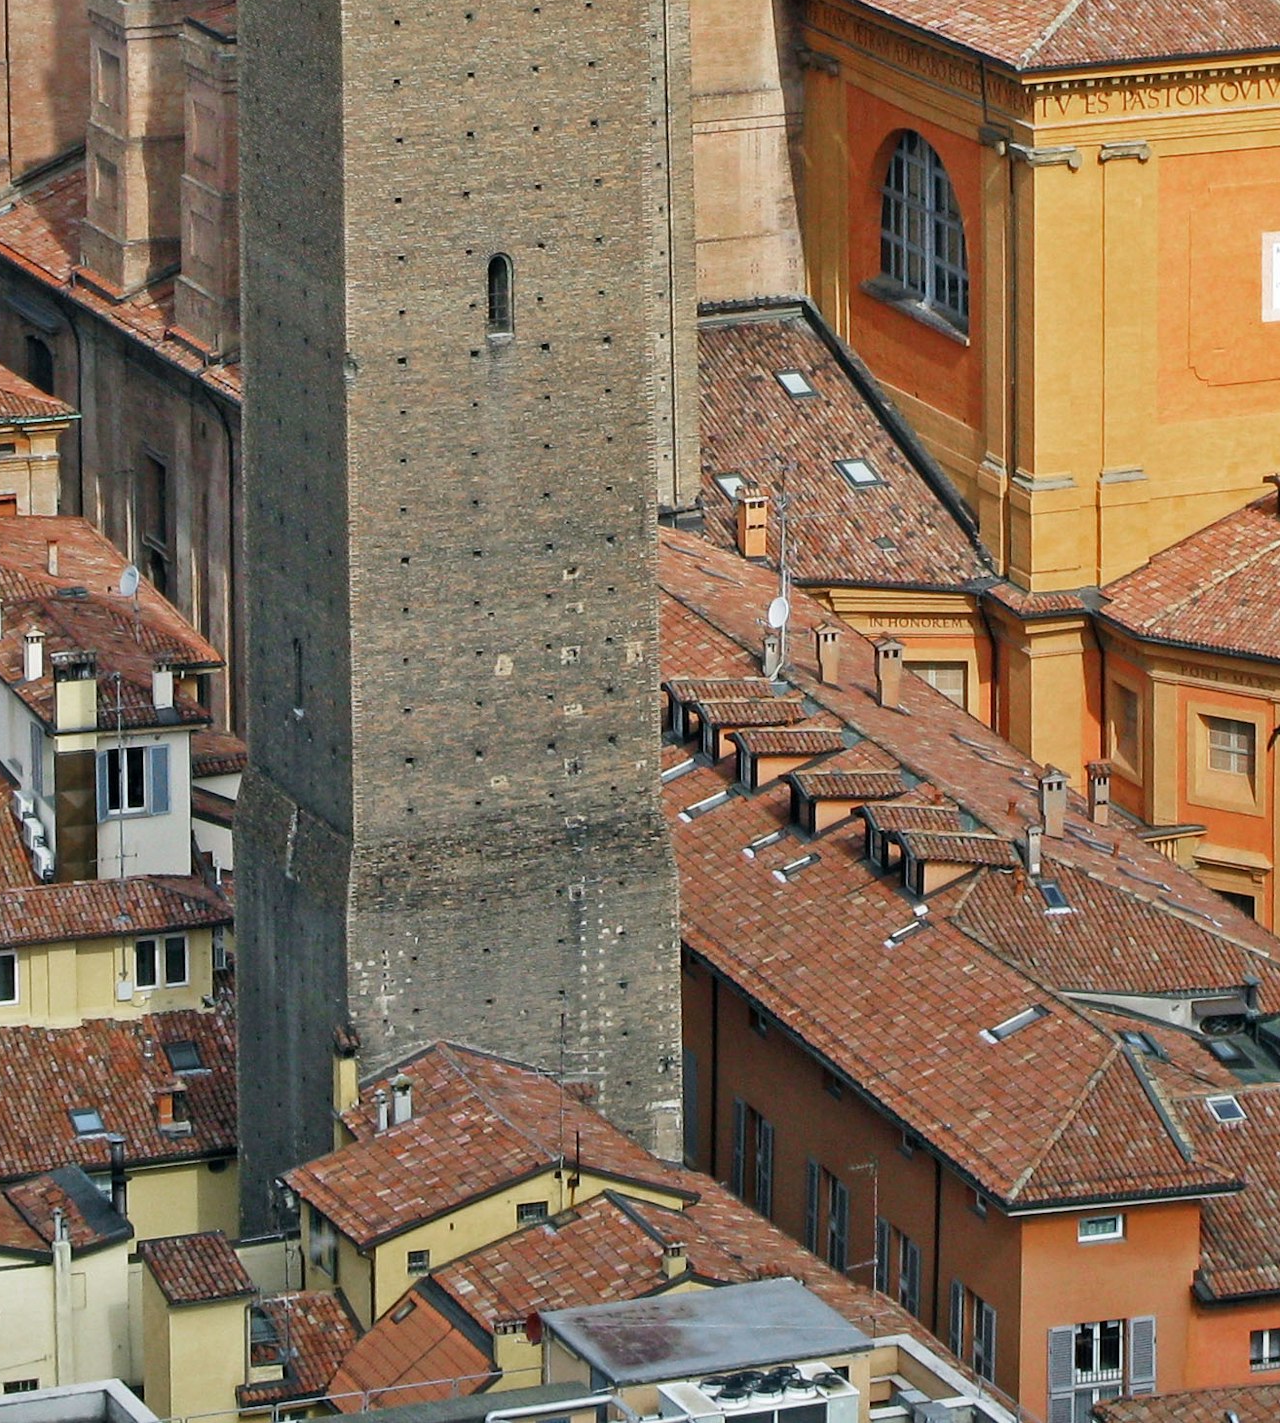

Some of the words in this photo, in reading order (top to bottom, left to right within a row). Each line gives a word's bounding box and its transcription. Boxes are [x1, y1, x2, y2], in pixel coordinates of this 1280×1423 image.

[1085, 92, 1110, 115] ES
[1122, 82, 1212, 111] PASTOR
[868, 617, 883, 629] IN
[886, 616, 962, 629] HONOREM
